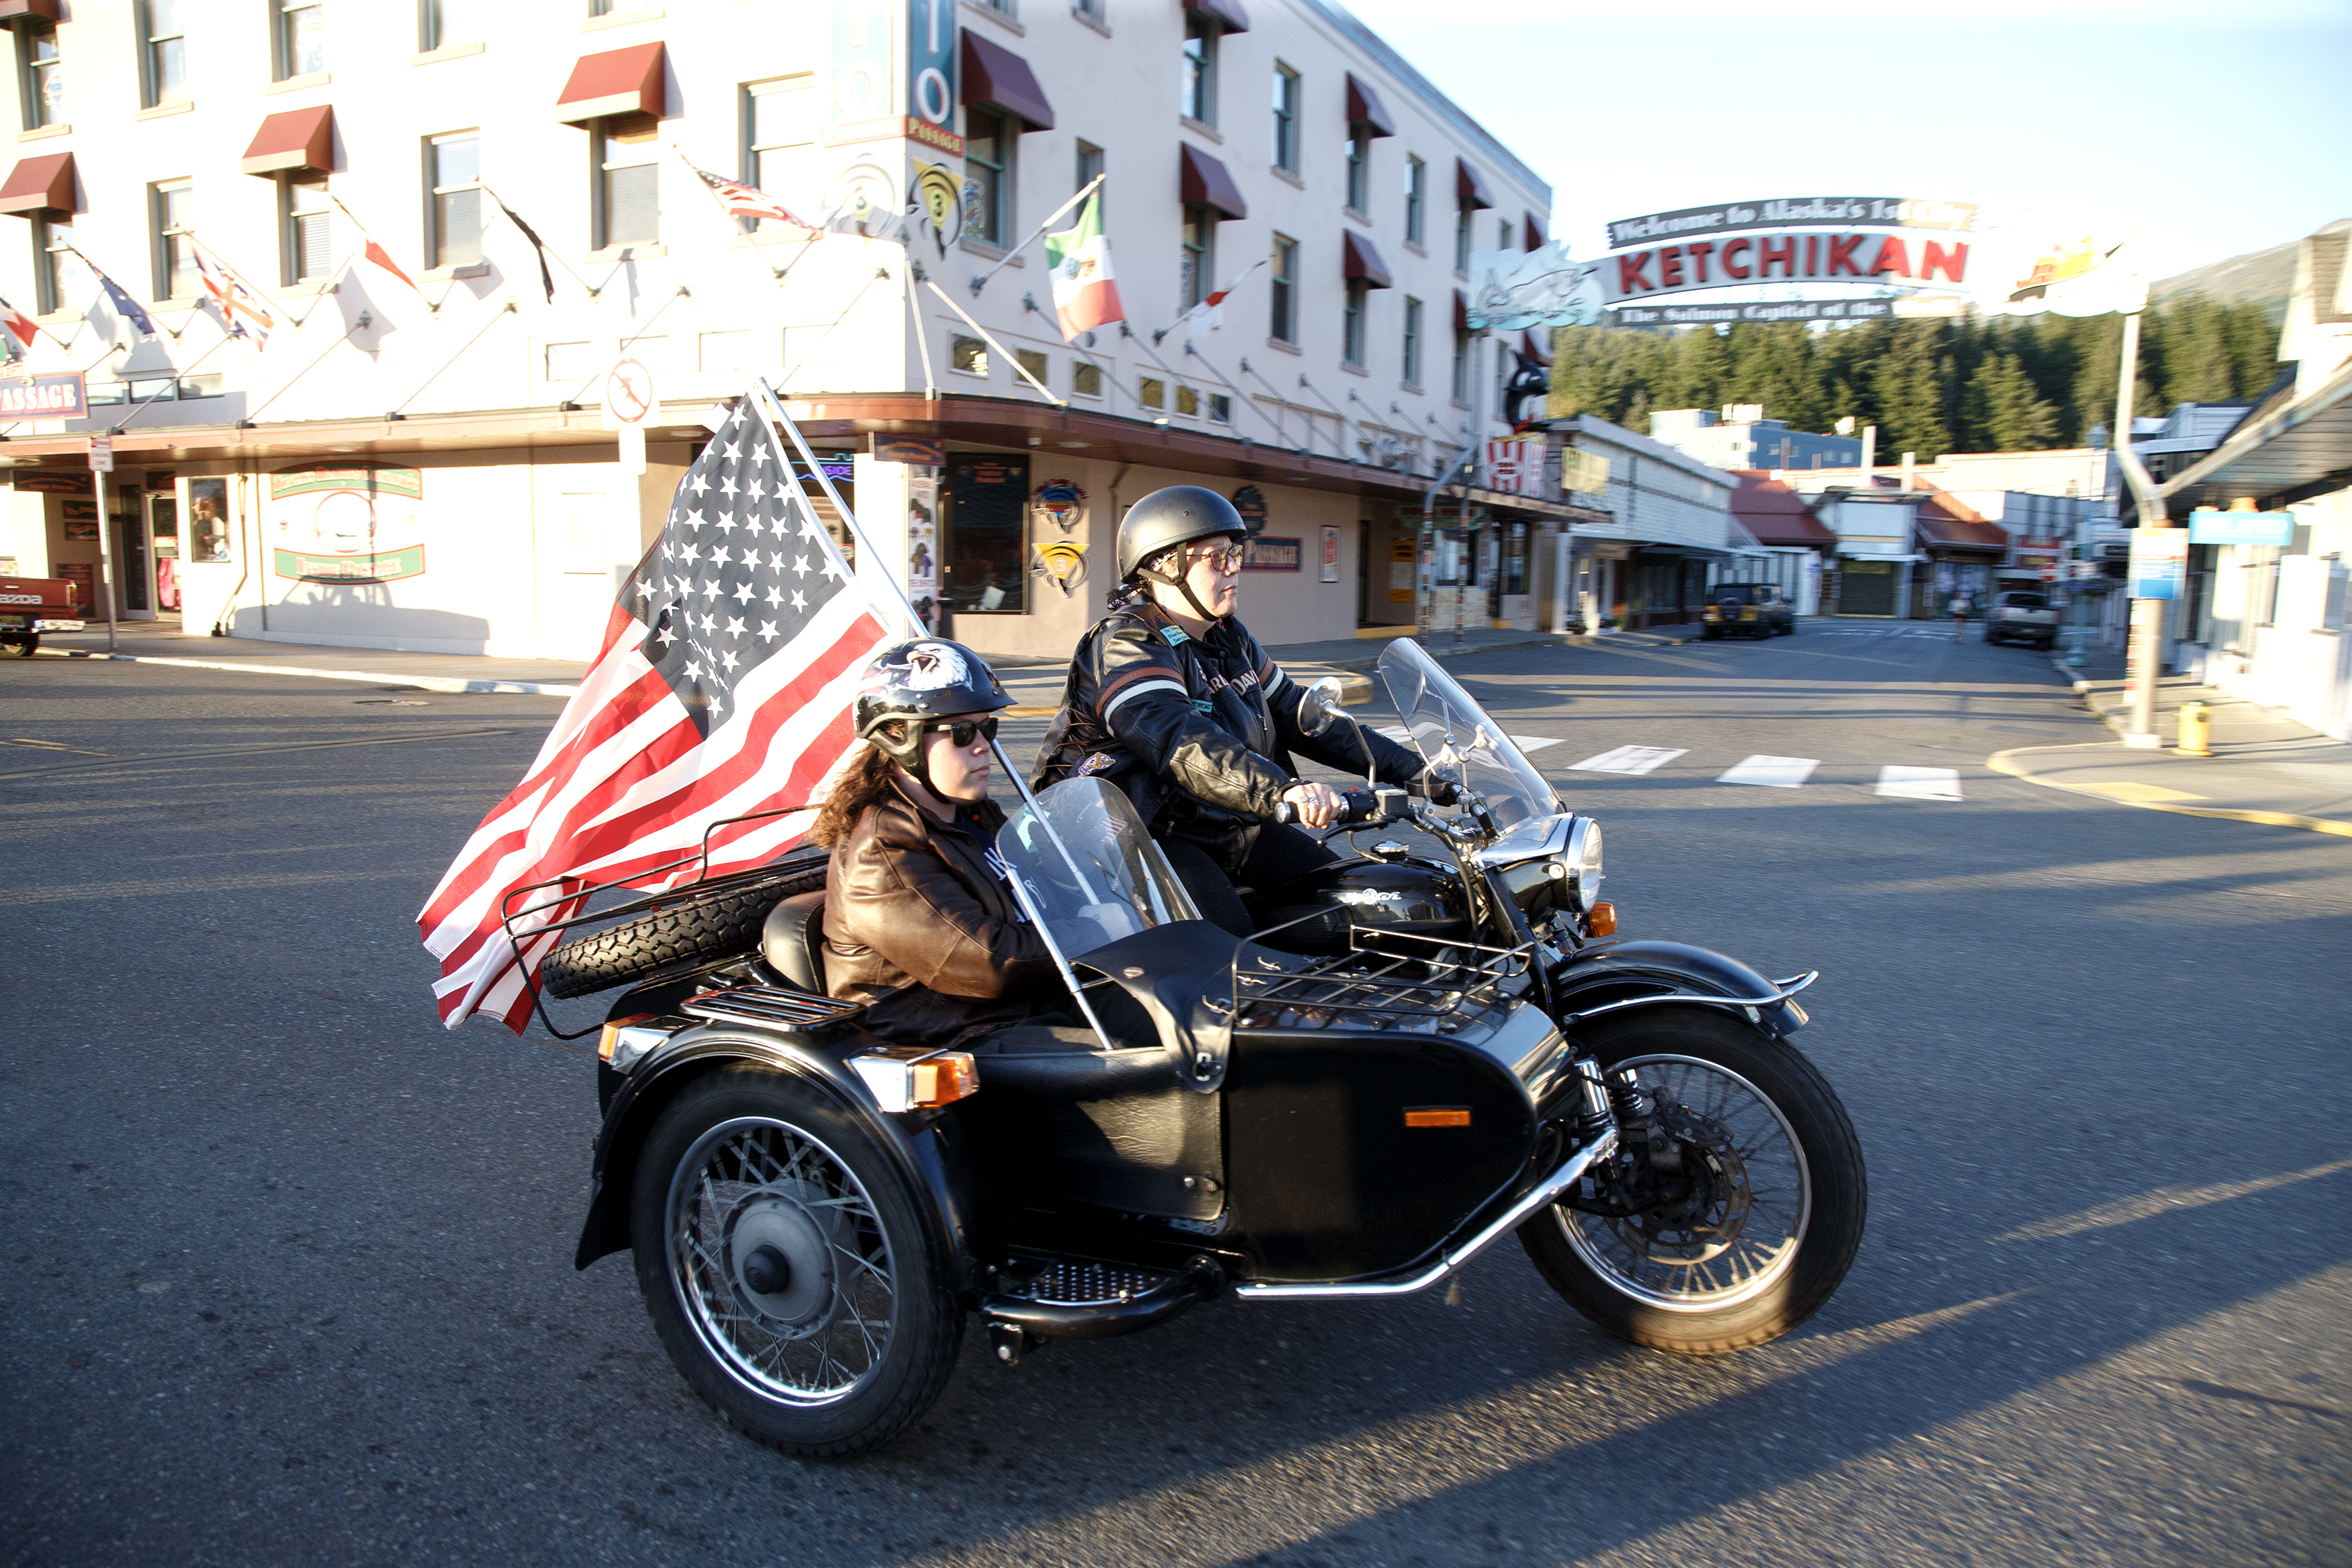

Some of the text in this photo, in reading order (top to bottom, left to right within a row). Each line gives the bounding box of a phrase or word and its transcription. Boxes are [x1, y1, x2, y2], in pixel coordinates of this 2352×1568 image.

[1612, 212, 1725, 242] Welcome
[1726, 205, 1757, 225] to
[1756, 198, 1866, 222] Alaska's
[1619, 234, 1969, 294] KETCHIKAN
[1619, 309, 1660, 323] The
[1663, 307, 1739, 321] Salmon
[0, 383, 76, 413] ASSAGE
[813, 465, 853, 475] SIDE
